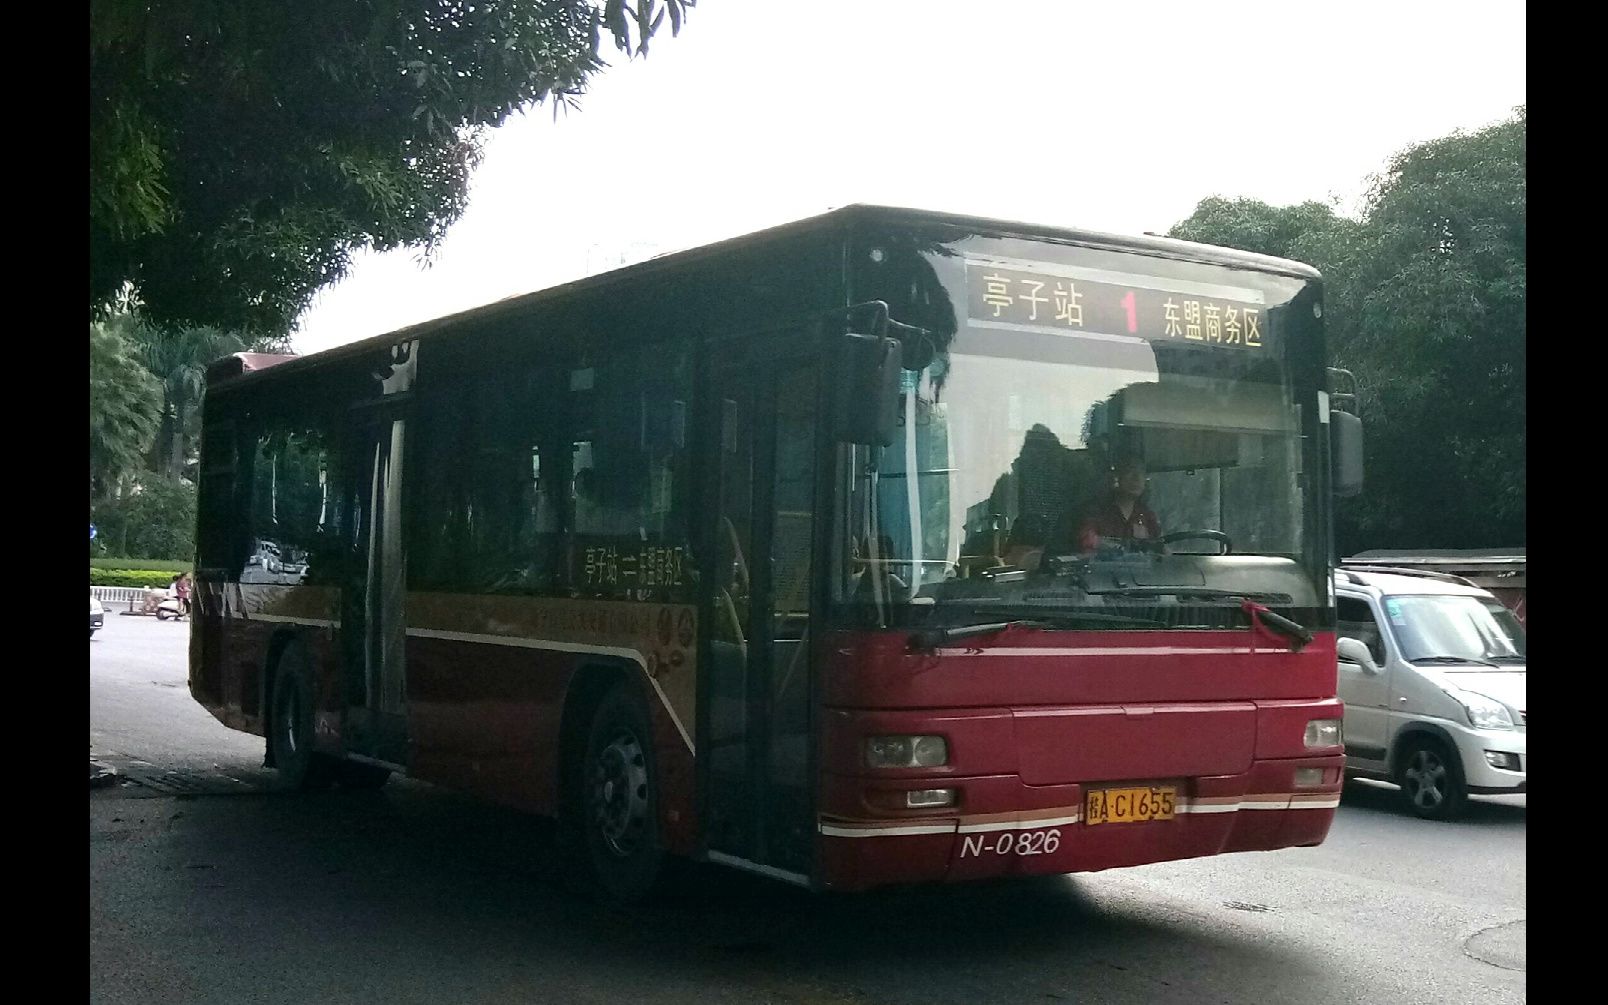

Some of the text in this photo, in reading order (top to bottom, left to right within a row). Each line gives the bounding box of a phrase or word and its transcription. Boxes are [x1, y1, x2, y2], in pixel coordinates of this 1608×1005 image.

[982, 272, 1262, 347] 亭子站 1 东盟商务区
[584, 545, 619, 586] 亭子站
[960, 828, 1062, 859] N-0826
